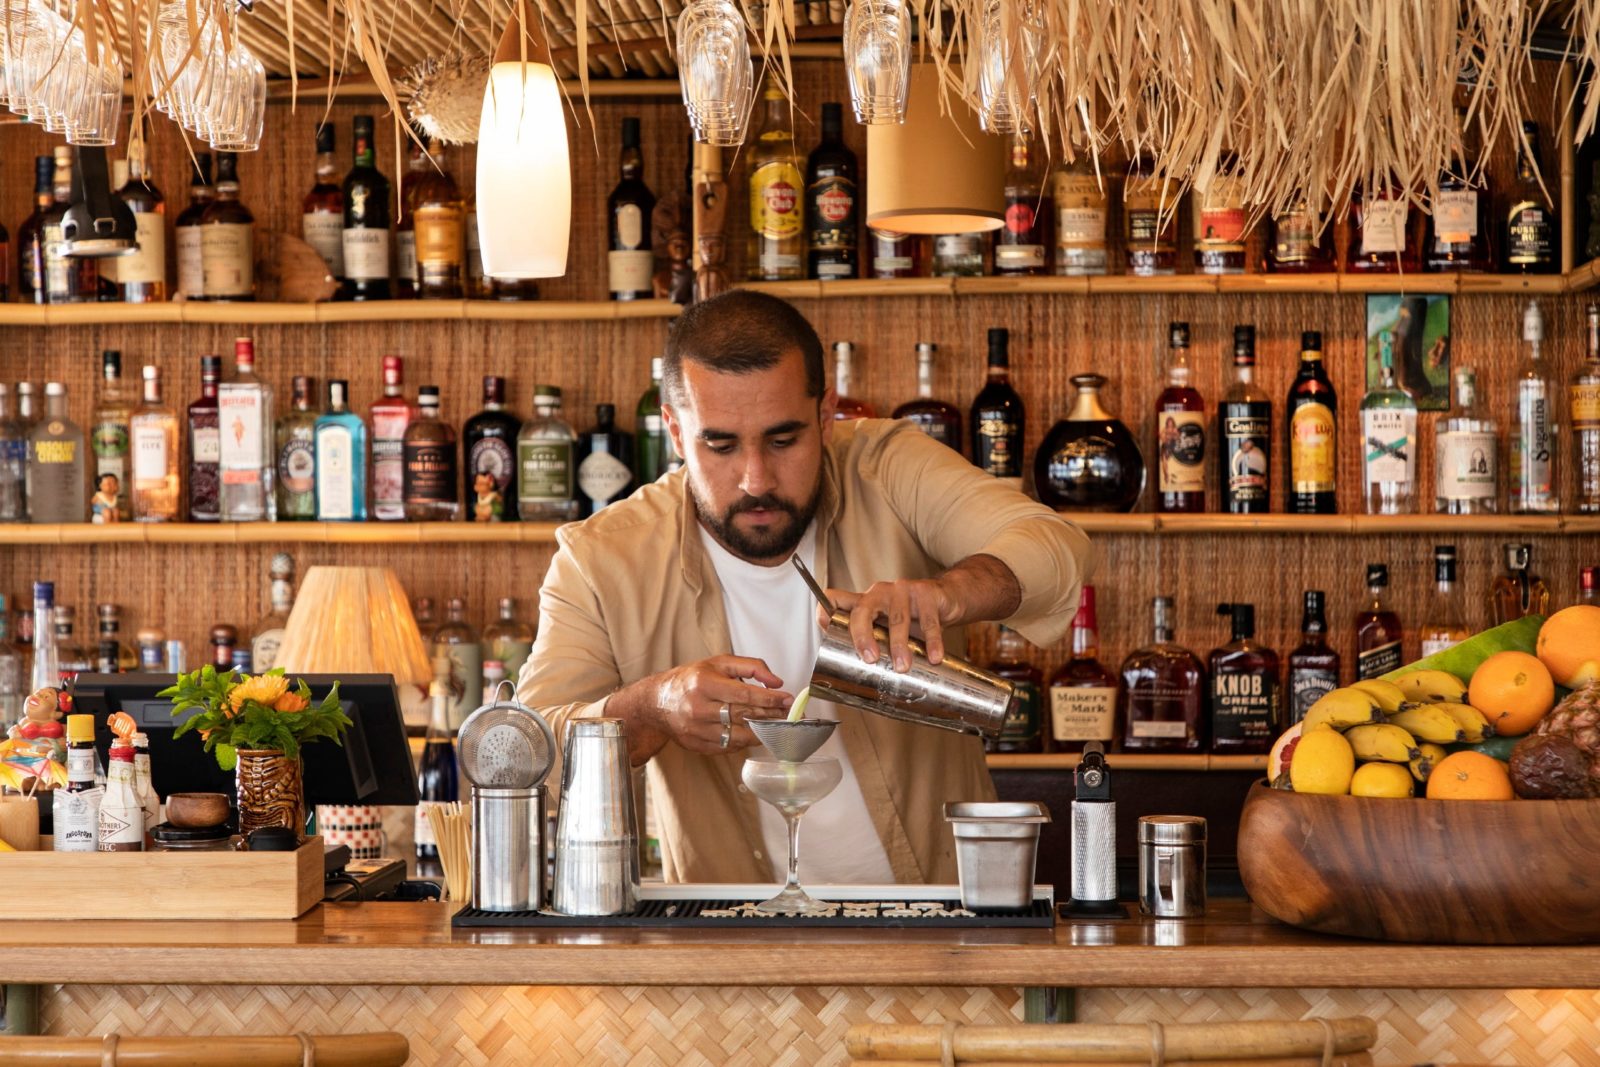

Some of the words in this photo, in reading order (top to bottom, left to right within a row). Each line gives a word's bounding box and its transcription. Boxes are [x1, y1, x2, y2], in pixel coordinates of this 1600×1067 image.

[1216, 674, 1262, 696] KNOB
[1221, 697, 1268, 705] CREEK
[1071, 704, 1108, 713] Mark
[1232, 706, 1248, 715] RYE
